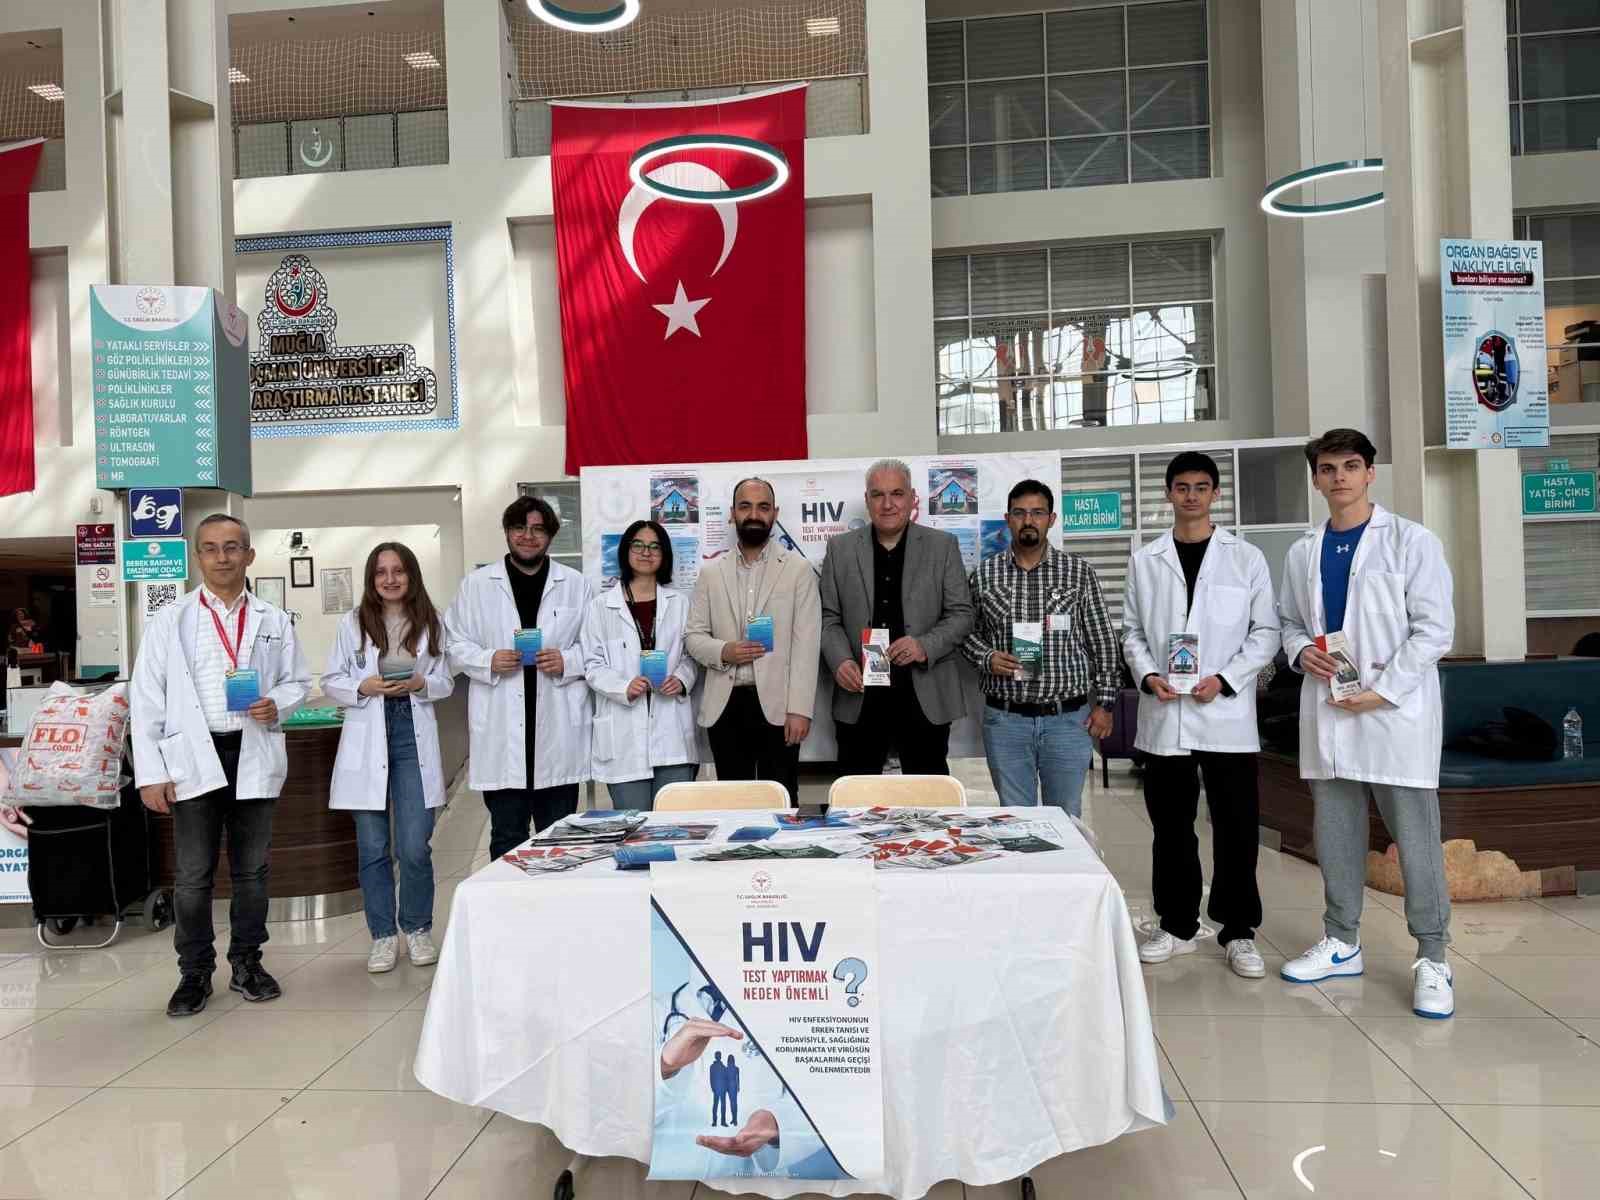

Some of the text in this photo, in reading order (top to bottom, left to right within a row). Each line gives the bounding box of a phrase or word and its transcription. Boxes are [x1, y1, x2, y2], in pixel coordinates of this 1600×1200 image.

[1446, 245, 1485, 258] ORGAN
[1523, 247, 1538, 259] VE
[106, 339, 190, 351] YATAKLI SERVİSLER
[271, 332, 325, 354] MUĞLA
[107, 353, 125, 365] GÖZ
[302, 352, 404, 379] ÜNİVERSİTESİ
[161, 368, 191, 380] TEDAVİ
[253, 379, 425, 412] ARAŞTIRMA HASTANESİ
[108, 397, 176, 409] SAĞLIK KURULU
[109, 413, 187, 424] LABORATUVARLAR
[110, 426, 150, 437] RÖNTGEN
[110, 442, 155, 452] ULTRASON
[111, 456, 160, 467] TOMOGRAFİ
[111, 471, 124, 481] MR
[1543, 477, 1576, 487] HASTA
[1074, 498, 1100, 511] HASTA
[801, 501, 844, 523] HIV
[33, 727, 81, 744] FLO
[742, 921, 826, 962] HIV
[743, 969, 828, 983] TEST YAPTIRMAK
[743, 985, 829, 1000] NEDEN ÖNEMLİ
[811, 1026, 870, 1034] ERKEN TANISI VE
[795, 1056, 846, 1065] BAŞKALARINA
